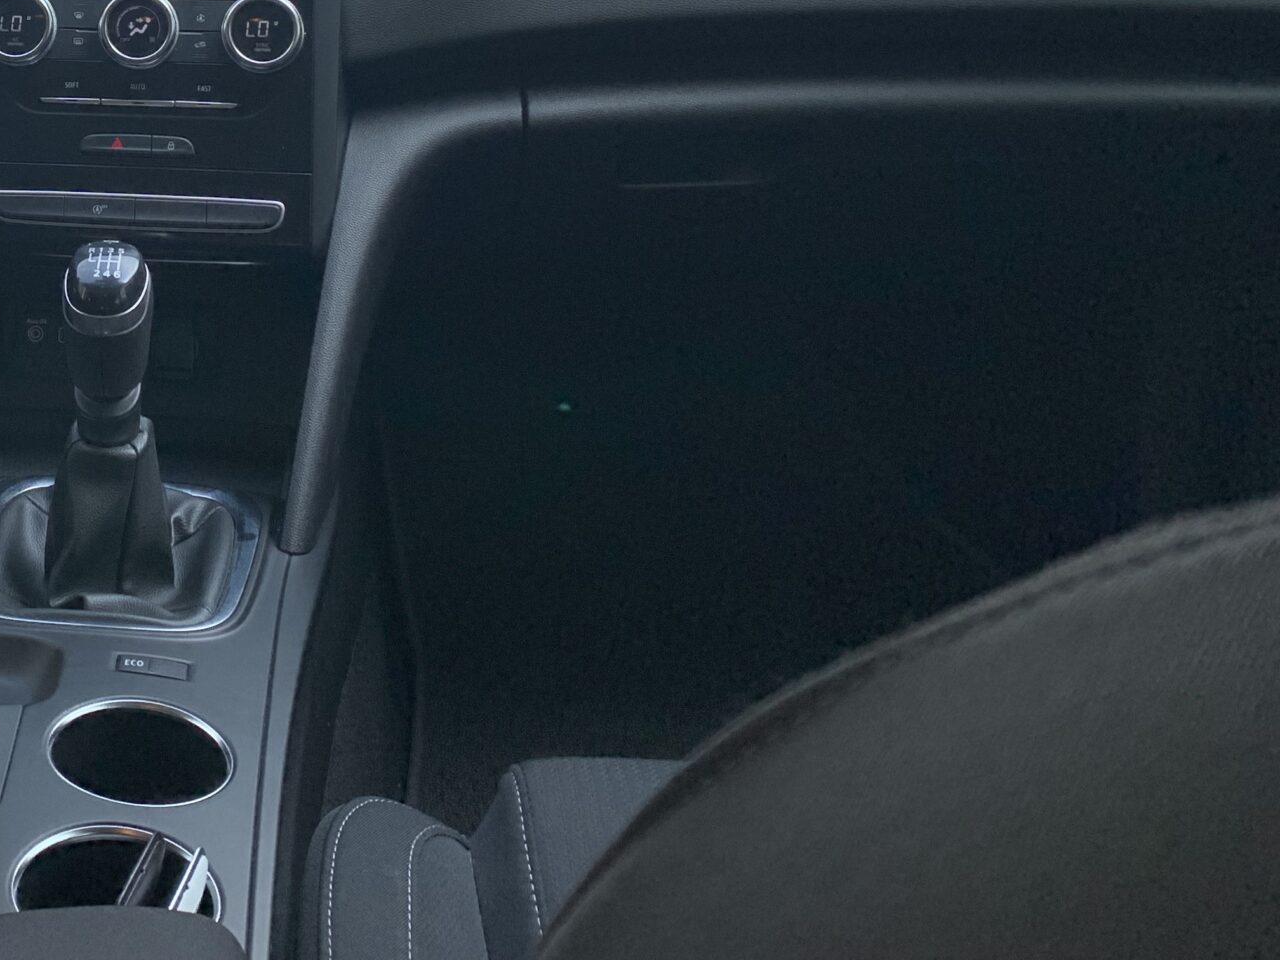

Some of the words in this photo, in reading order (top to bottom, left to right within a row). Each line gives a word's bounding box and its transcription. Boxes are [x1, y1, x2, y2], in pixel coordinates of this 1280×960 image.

[64, 81, 80, 89] SOFT
[129, 82, 146, 90] AUTO
[196, 84, 212, 92] FAST
[93, 269, 100, 278] 2
[102, 270, 111, 278] 4
[113, 271, 121, 279] 6
[124, 658, 145, 668] ECO
